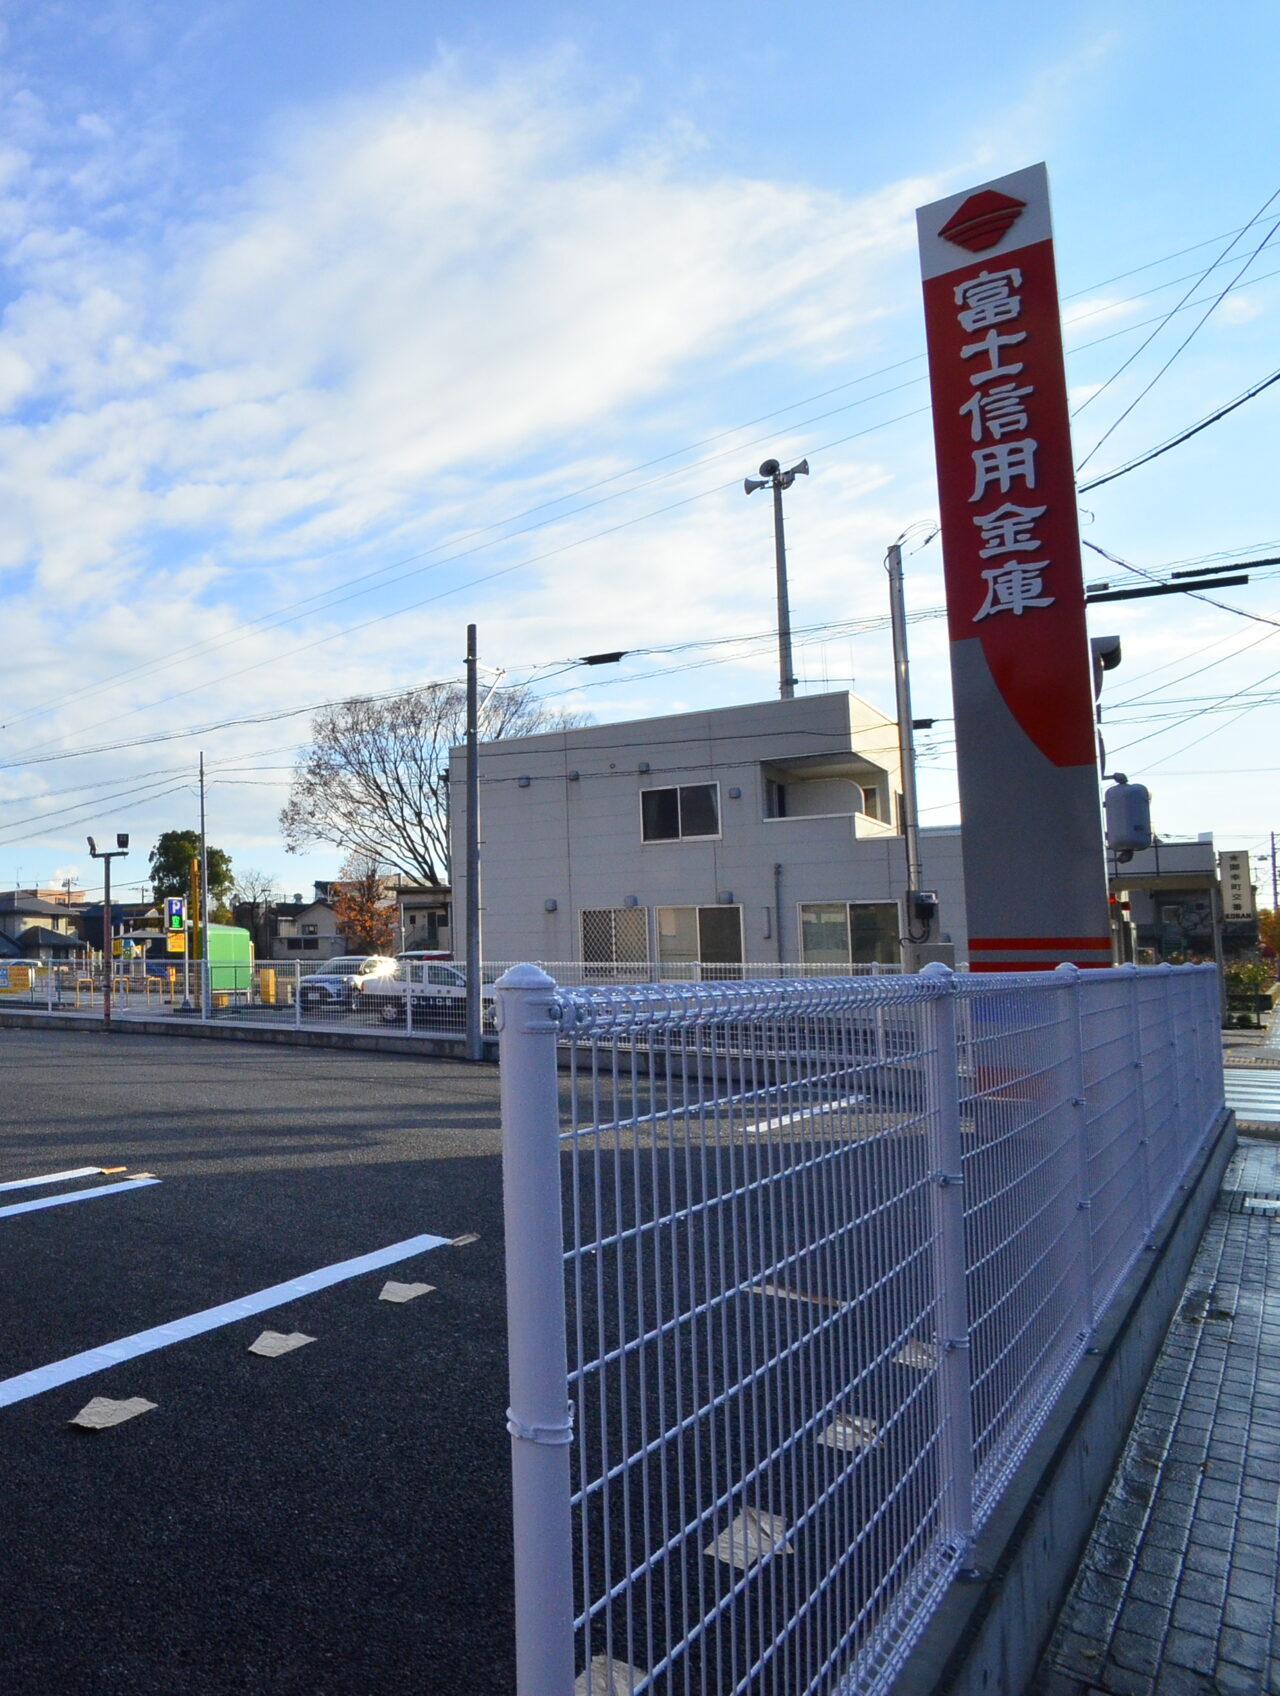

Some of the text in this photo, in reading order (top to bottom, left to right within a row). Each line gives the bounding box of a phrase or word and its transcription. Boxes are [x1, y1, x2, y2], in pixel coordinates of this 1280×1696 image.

[953, 270, 1056, 622] 富士信用金庫
[172, 900, 180, 914] P
[401, 997, 452, 1005] POLICE
